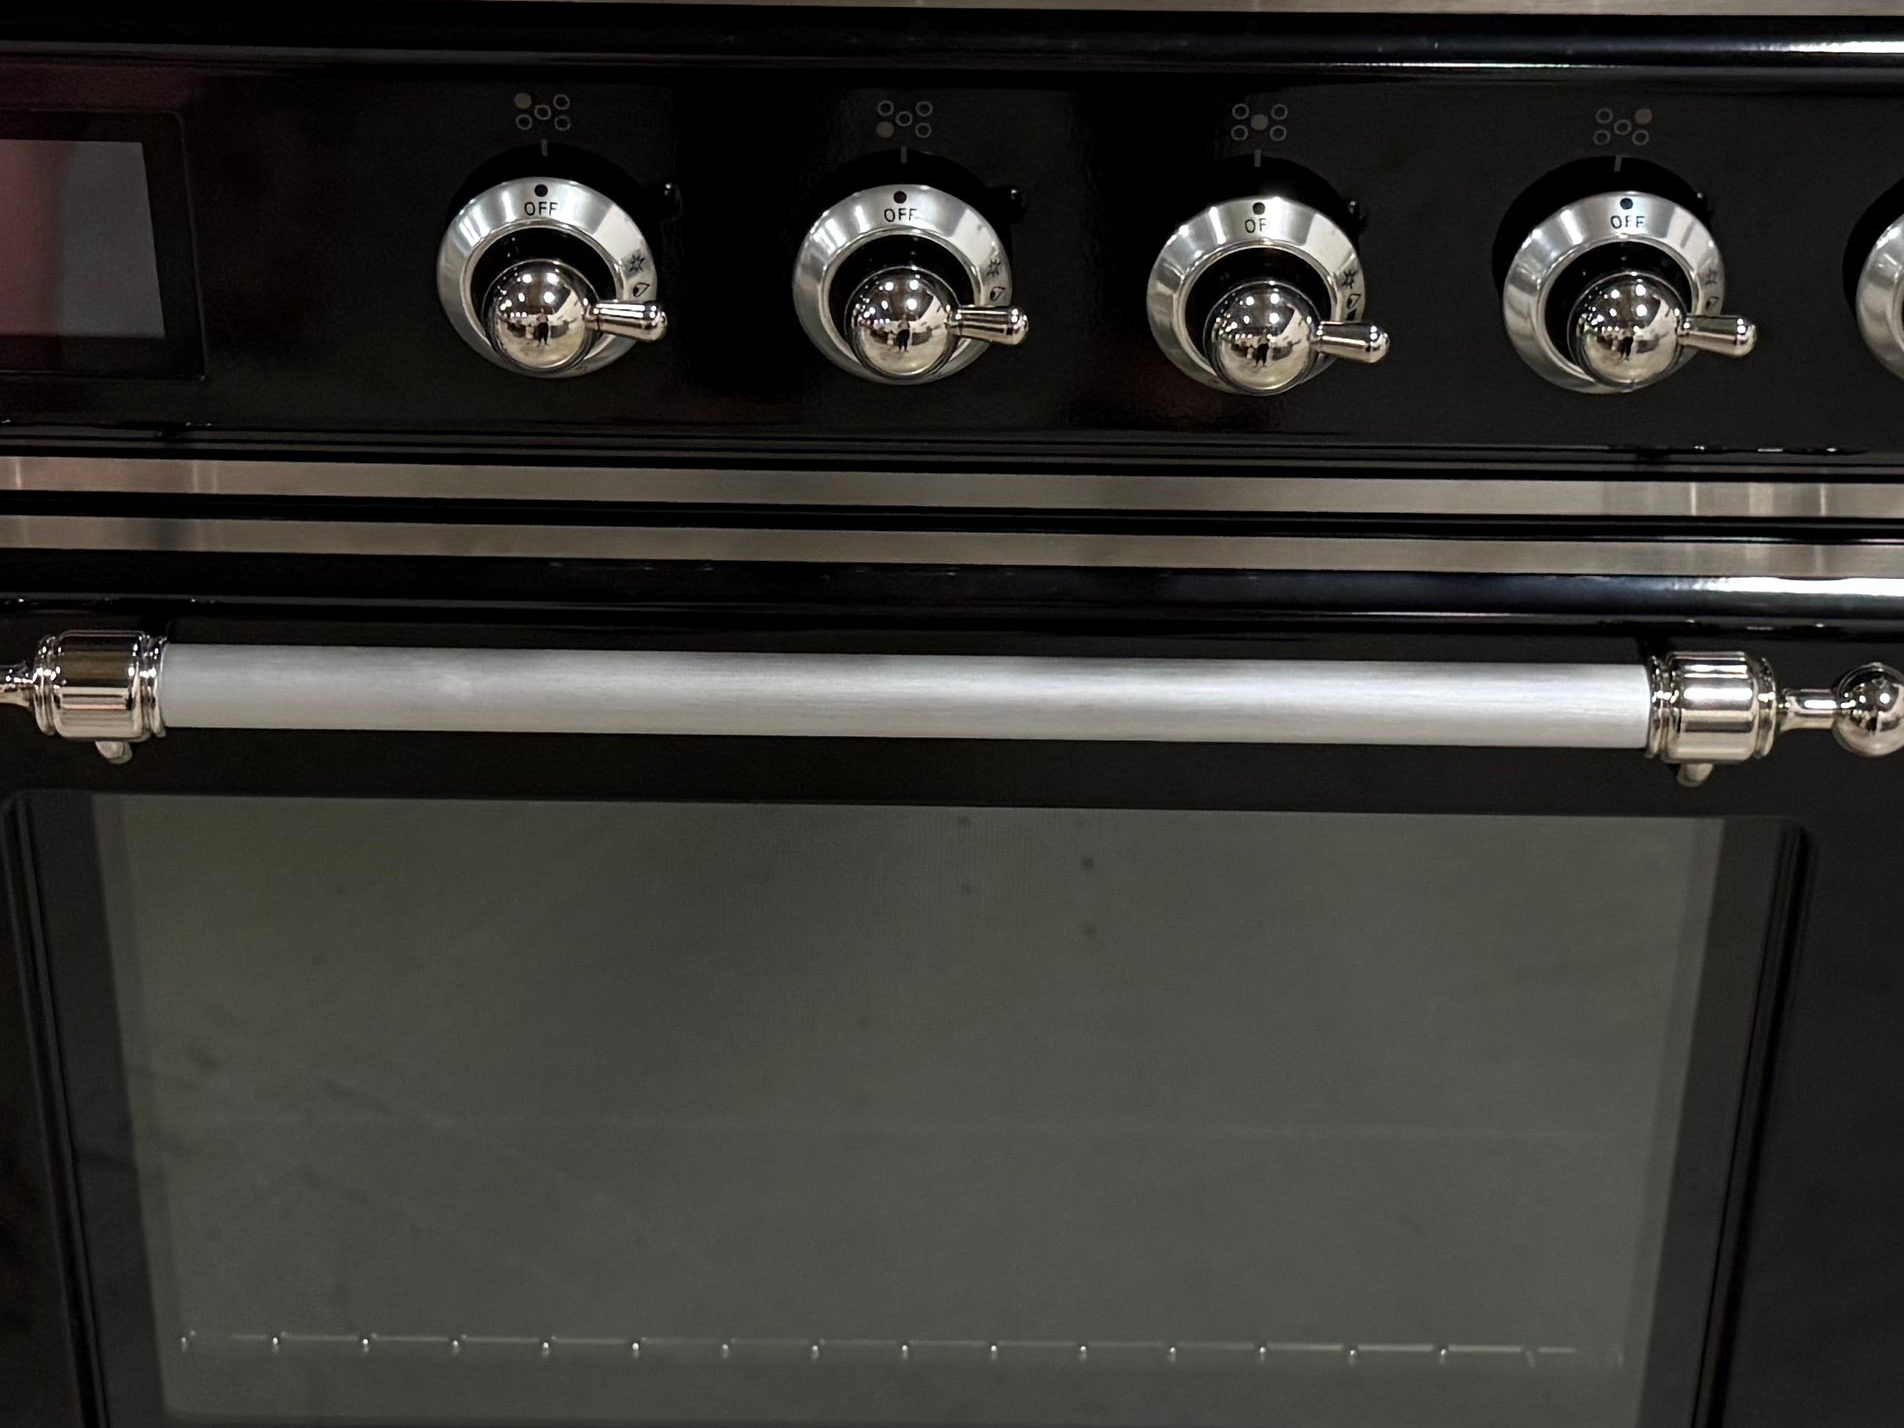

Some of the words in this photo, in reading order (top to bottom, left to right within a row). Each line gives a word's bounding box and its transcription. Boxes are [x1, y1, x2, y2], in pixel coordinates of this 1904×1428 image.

[524, 201, 558, 216] OFF
[884, 208, 917, 222] OFF
[1244, 217, 1272, 233] OF
[1610, 215, 1645, 229] OFF
